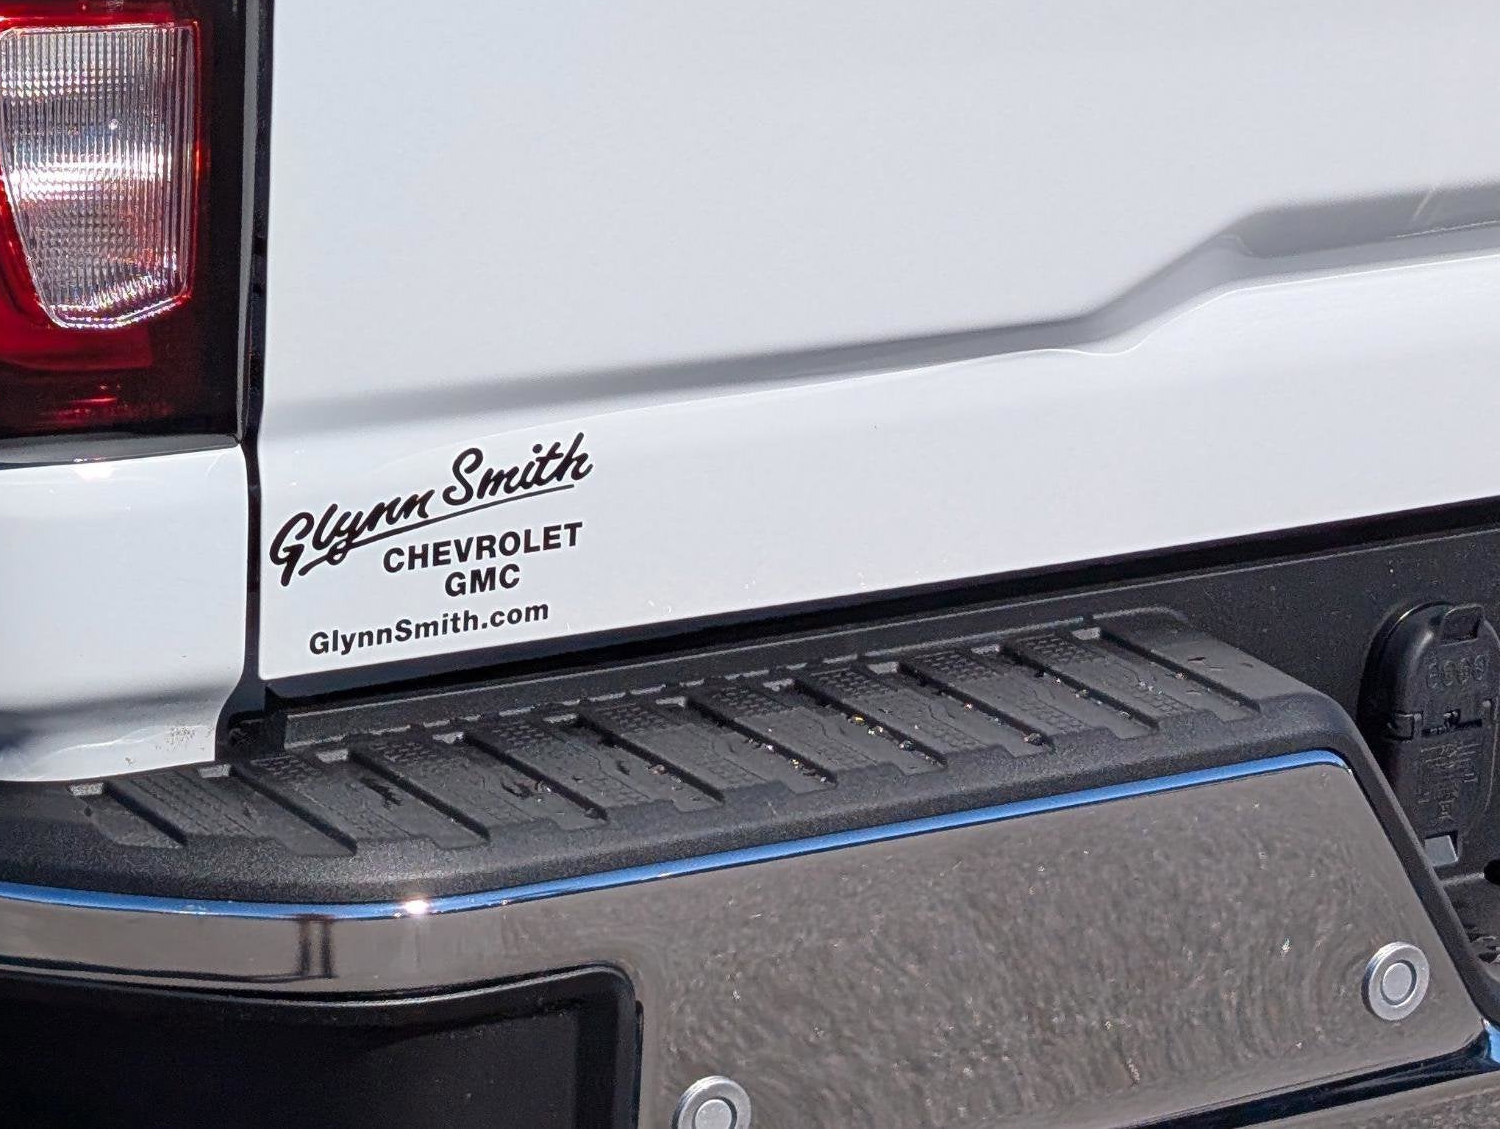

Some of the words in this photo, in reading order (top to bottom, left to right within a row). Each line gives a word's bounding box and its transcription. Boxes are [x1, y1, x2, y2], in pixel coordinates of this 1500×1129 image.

[269, 488, 436, 587] Glynn
[442, 431, 594, 506] Smith
[383, 521, 583, 573] CHEVROLET
[444, 563, 520, 597] GMC
[308, 602, 550, 655] GlynnSmith.com
